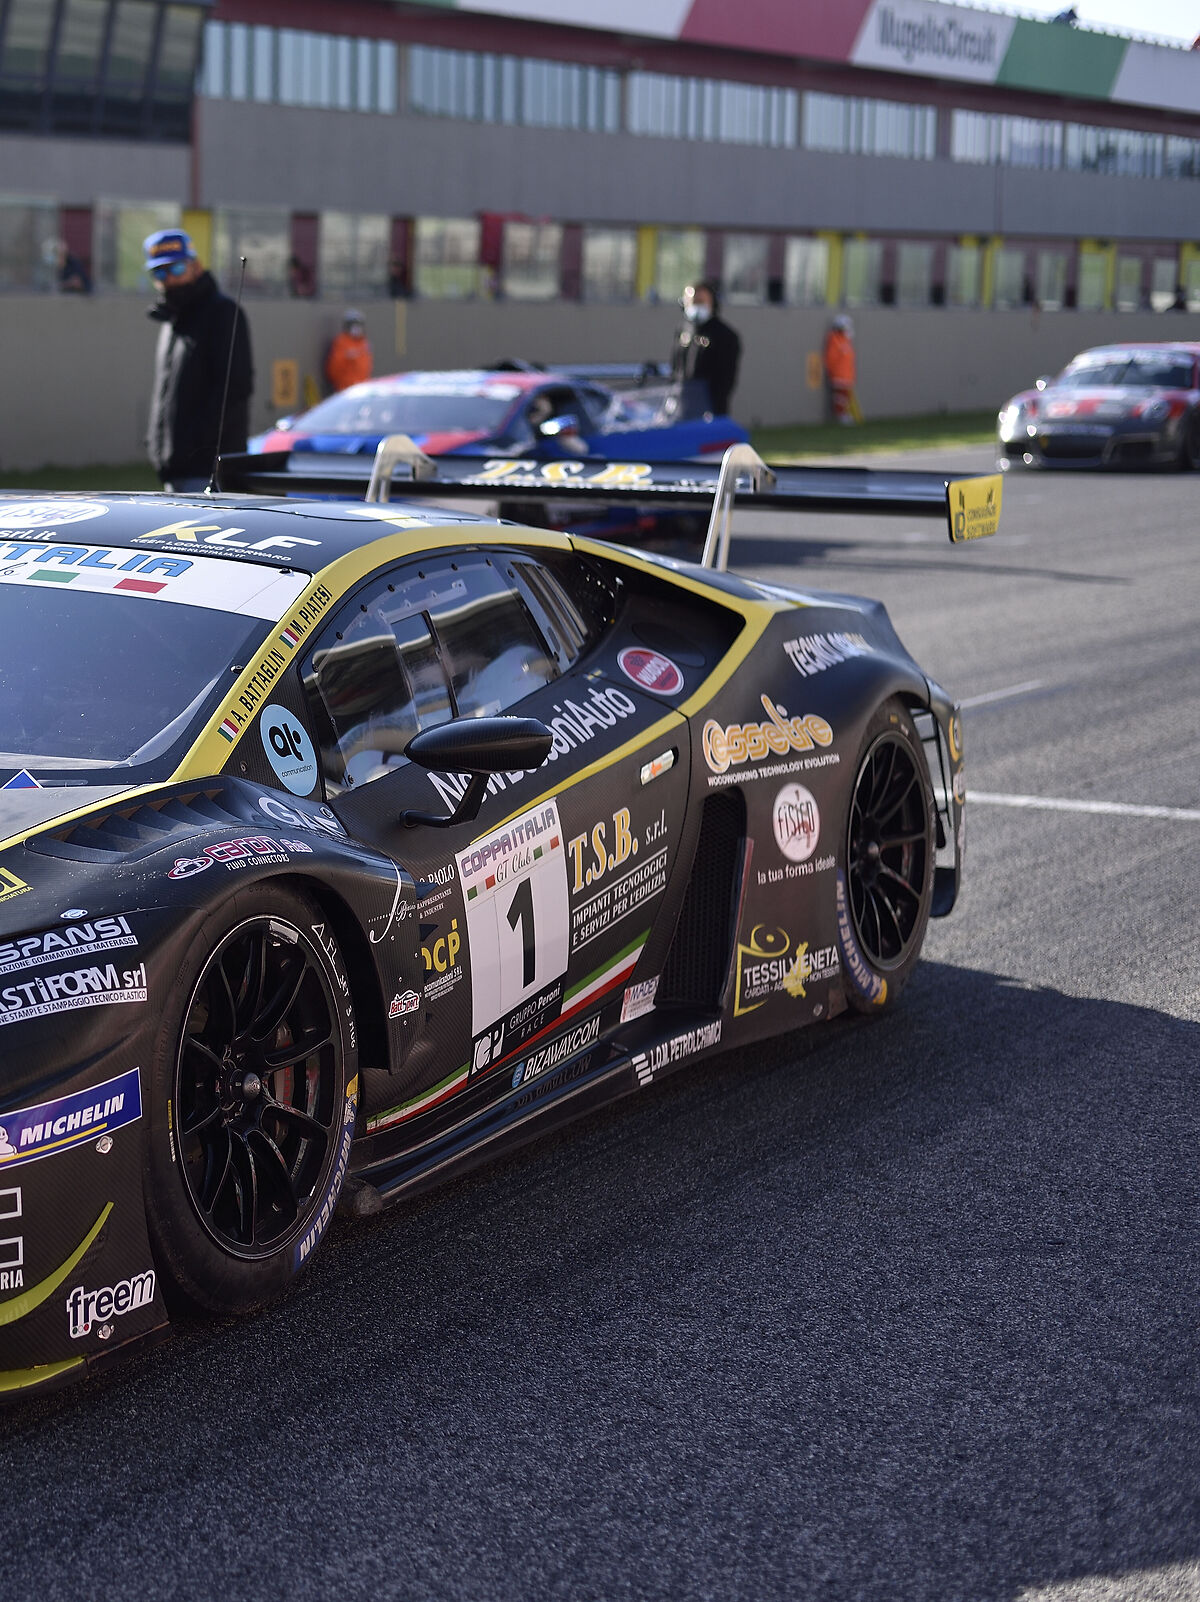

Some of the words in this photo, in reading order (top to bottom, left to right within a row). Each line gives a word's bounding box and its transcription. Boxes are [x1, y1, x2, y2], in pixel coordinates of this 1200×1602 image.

[130, 538, 167, 546] KEEP
[167, 541, 223, 551] LOOKING
[225, 546, 292, 561] FORWARD
[138, 520, 322, 550] KLF
[298, 584, 334, 625] PIATESI
[238, 648, 286, 713] BATTAGLIN
[230, 709, 249, 728] A.
[702, 694, 834, 774] essetre
[281, 764, 314, 778] communication
[707, 766, 759, 787] WOODWORKING
[757, 761, 804, 778] TECHNOLOGY
[804, 753, 840, 769] EVOLUTION
[202, 835, 285, 862] caron
[225, 859, 246, 871] FLUID
[247, 853, 290, 867] CONNECTORS
[496, 859, 509, 883] GT
[512, 847, 532, 873] Club
[757, 870, 767, 885] la
[768, 868, 784, 882] tua
[785, 863, 815, 879] forma
[815, 854, 836, 872] ideale
[573, 892, 611, 929] IMPIANTI
[613, 853, 667, 901] TECNOLOGICI
[573, 931, 578, 946] E
[580, 910, 611, 941] SERVIZI
[613, 897, 628, 918] PER
[629, 870, 667, 906] L'EDILIZIA
[507, 876, 536, 990] 1
[31, 946, 86, 966] GOMMAPIUMA
[93, 936, 137, 952] MATERASSI
[743, 945, 840, 988] TESSILVENETA
[125, 962, 148, 988] srl
[8, 1007, 38, 1021] STAMPI
[43, 996, 90, 1013] STAMPAGGIO
[89, 992, 120, 1005] TECNICO
[119, 989, 147, 1001] PLASTICO
[509, 1001, 537, 1029] GRUPPO
[538, 982, 561, 1010] Peroni
[520, 1012, 546, 1039] RACE
[523, 1015, 601, 1081] BIZAWAY.COM
[19, 1092, 126, 1147] MICHELIN
[67, 1269, 156, 1339] freem
